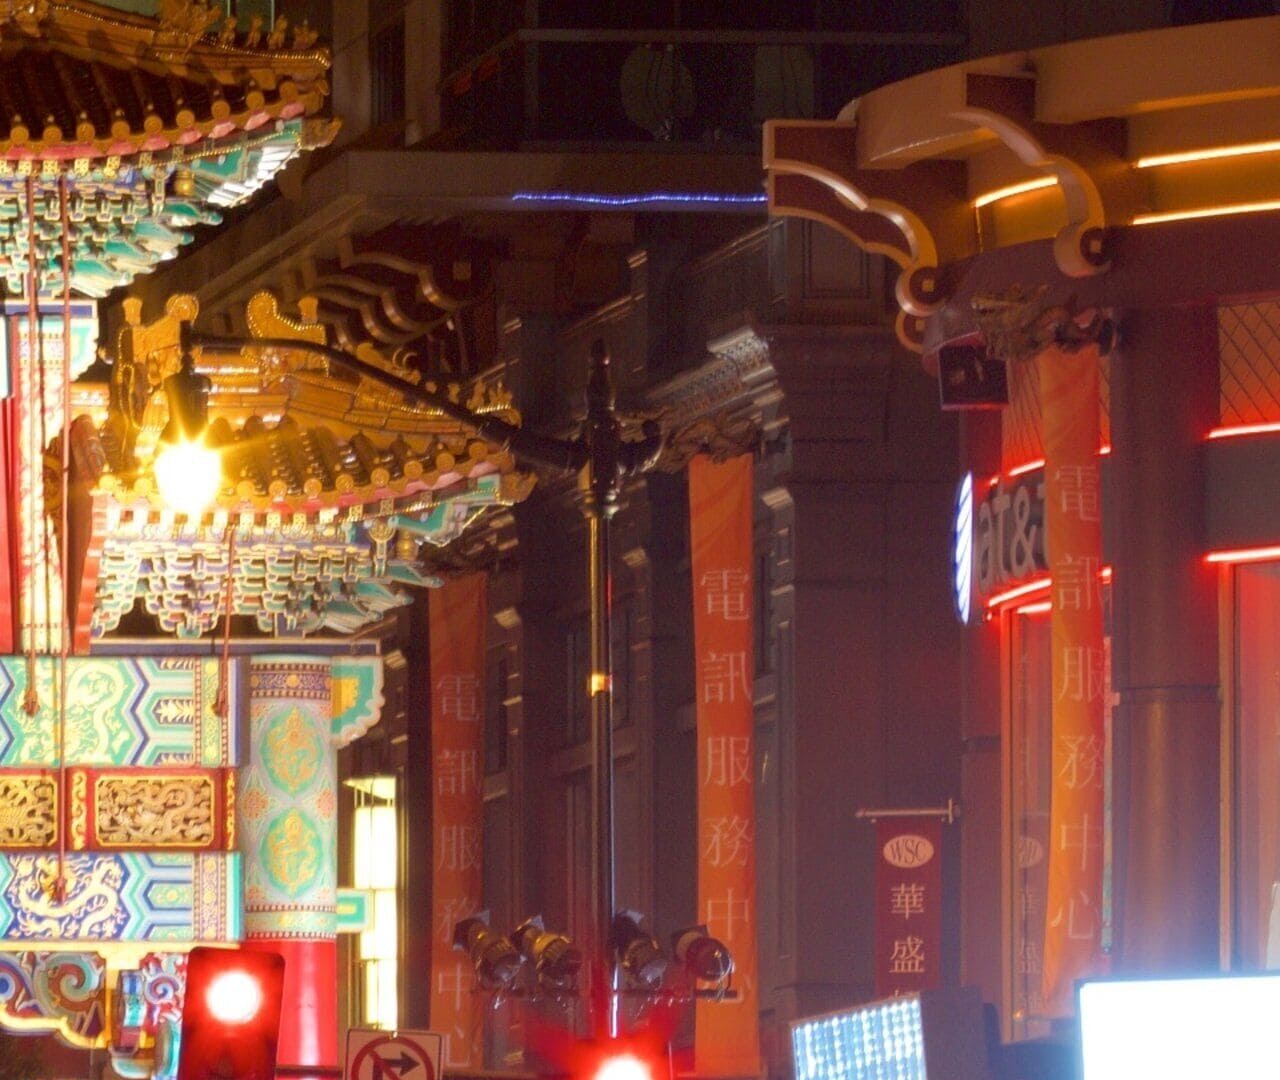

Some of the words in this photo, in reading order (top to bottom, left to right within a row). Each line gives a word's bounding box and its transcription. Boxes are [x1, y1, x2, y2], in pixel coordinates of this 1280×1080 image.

[700, 568, 753, 1003] 電訊服務中
[890, 883, 926, 997] 華盛
